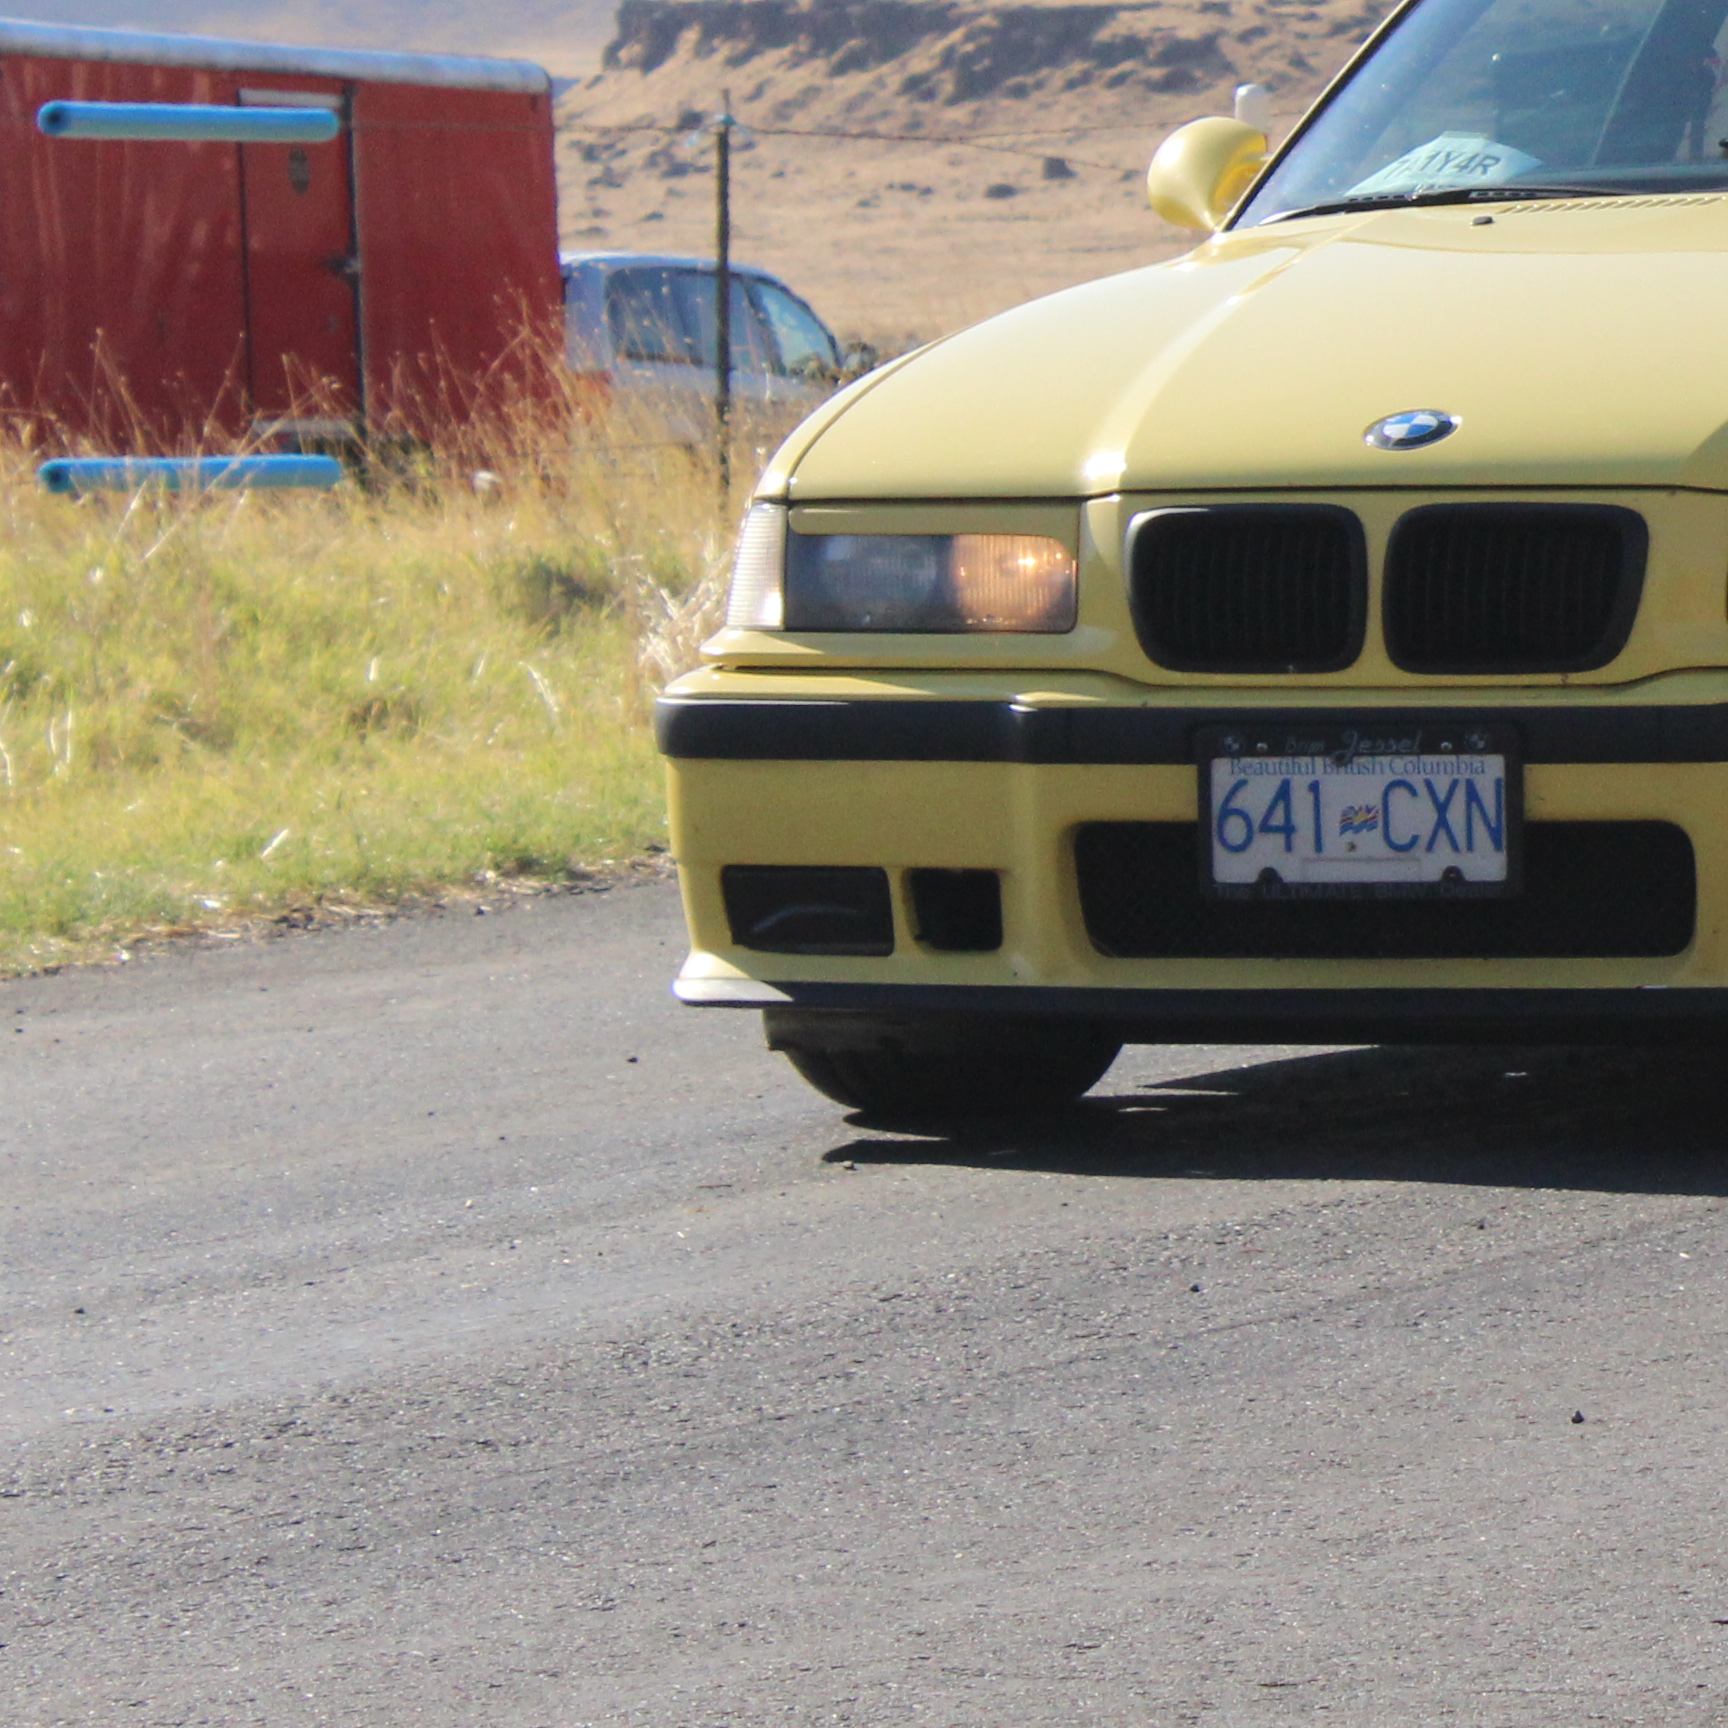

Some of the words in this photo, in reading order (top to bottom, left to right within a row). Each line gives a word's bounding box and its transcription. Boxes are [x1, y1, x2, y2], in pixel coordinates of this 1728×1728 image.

[1229, 757, 1316, 776] Beautiful
[1390, 755, 1486, 776] Columbia
[1216, 778, 1323, 854] 641
[1381, 777, 1505, 854] CXN
